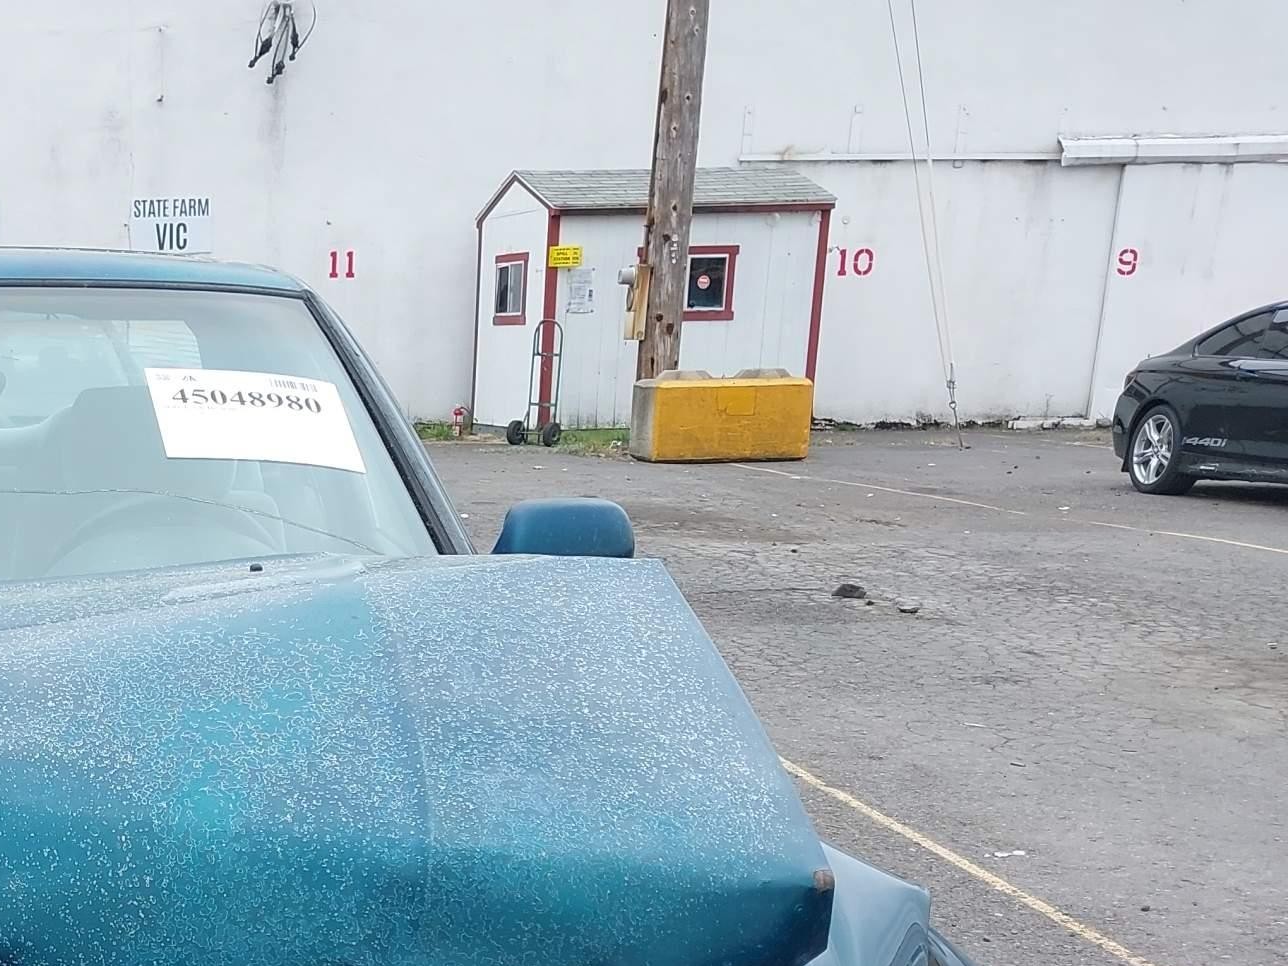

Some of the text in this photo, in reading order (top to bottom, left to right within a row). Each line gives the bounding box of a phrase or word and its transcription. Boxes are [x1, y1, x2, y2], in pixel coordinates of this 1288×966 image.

[133, 198, 210, 218] STATE FARM
[155, 222, 188, 251] VIC
[329, 250, 355, 278] 11
[837, 248, 874, 276] 10
[1116, 248, 1138, 276] 9
[171, 388, 323, 414] 45048980
